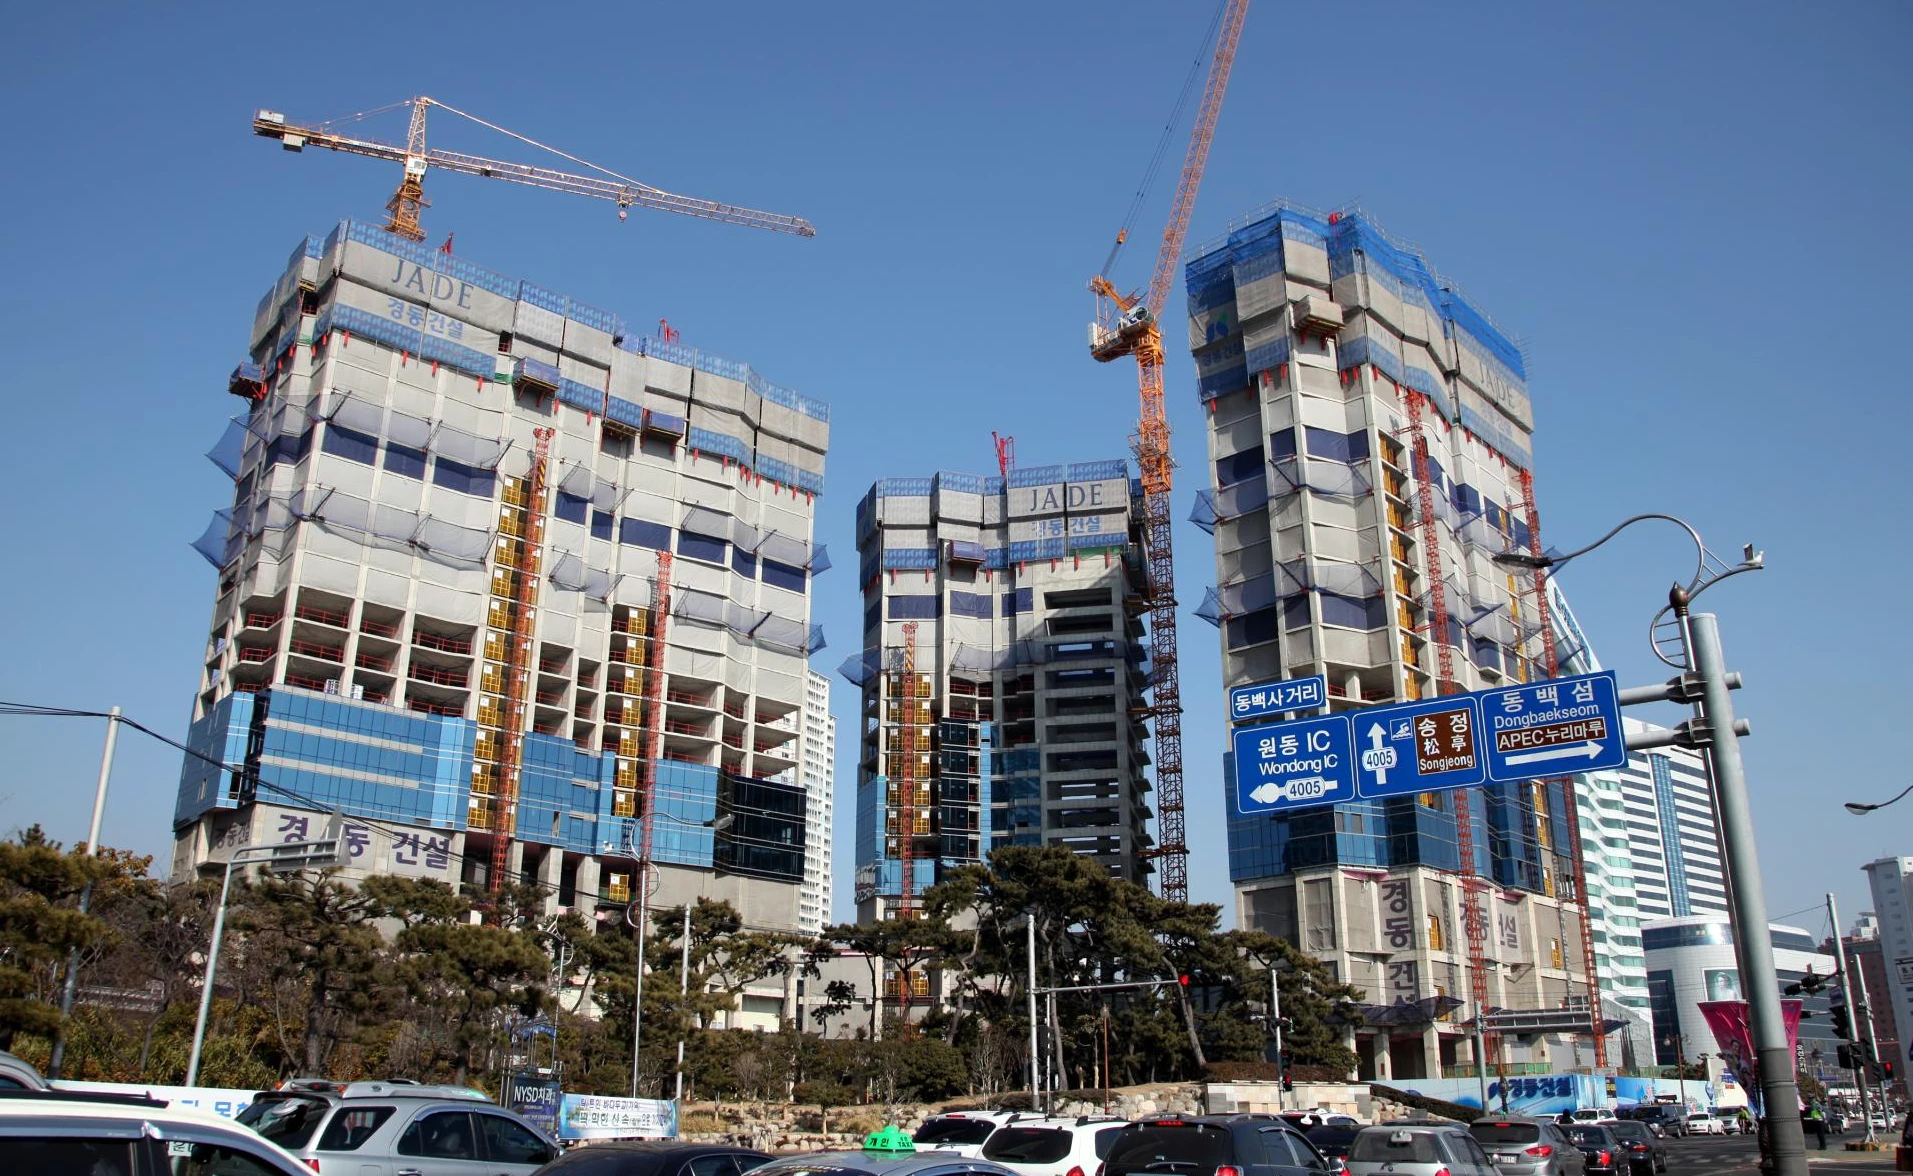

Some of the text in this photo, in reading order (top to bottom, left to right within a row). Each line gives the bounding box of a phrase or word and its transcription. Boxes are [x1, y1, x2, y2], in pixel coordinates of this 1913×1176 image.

[391, 258, 474, 310] JADE
[388, 297, 464, 341] 경동건설
[1478, 361, 1516, 410] JADE
[1030, 483, 1103, 512] JADE
[1032, 515, 1101, 537] 경동건설
[1234, 683, 1318, 711] 동백사거리
[1494, 704, 1600, 731] Dongbaekseom
[1258, 730, 1331, 759] 원동 IC
[1499, 720, 1606, 749] APEC누리마루
[1259, 753, 1338, 776] Wondong IC
[1366, 750, 1393, 768] 4005
[1420, 754, 1474, 772] Songjeong
[1289, 780, 1321, 797] 4005
[1509, 1077, 1572, 1099] 경동건설
